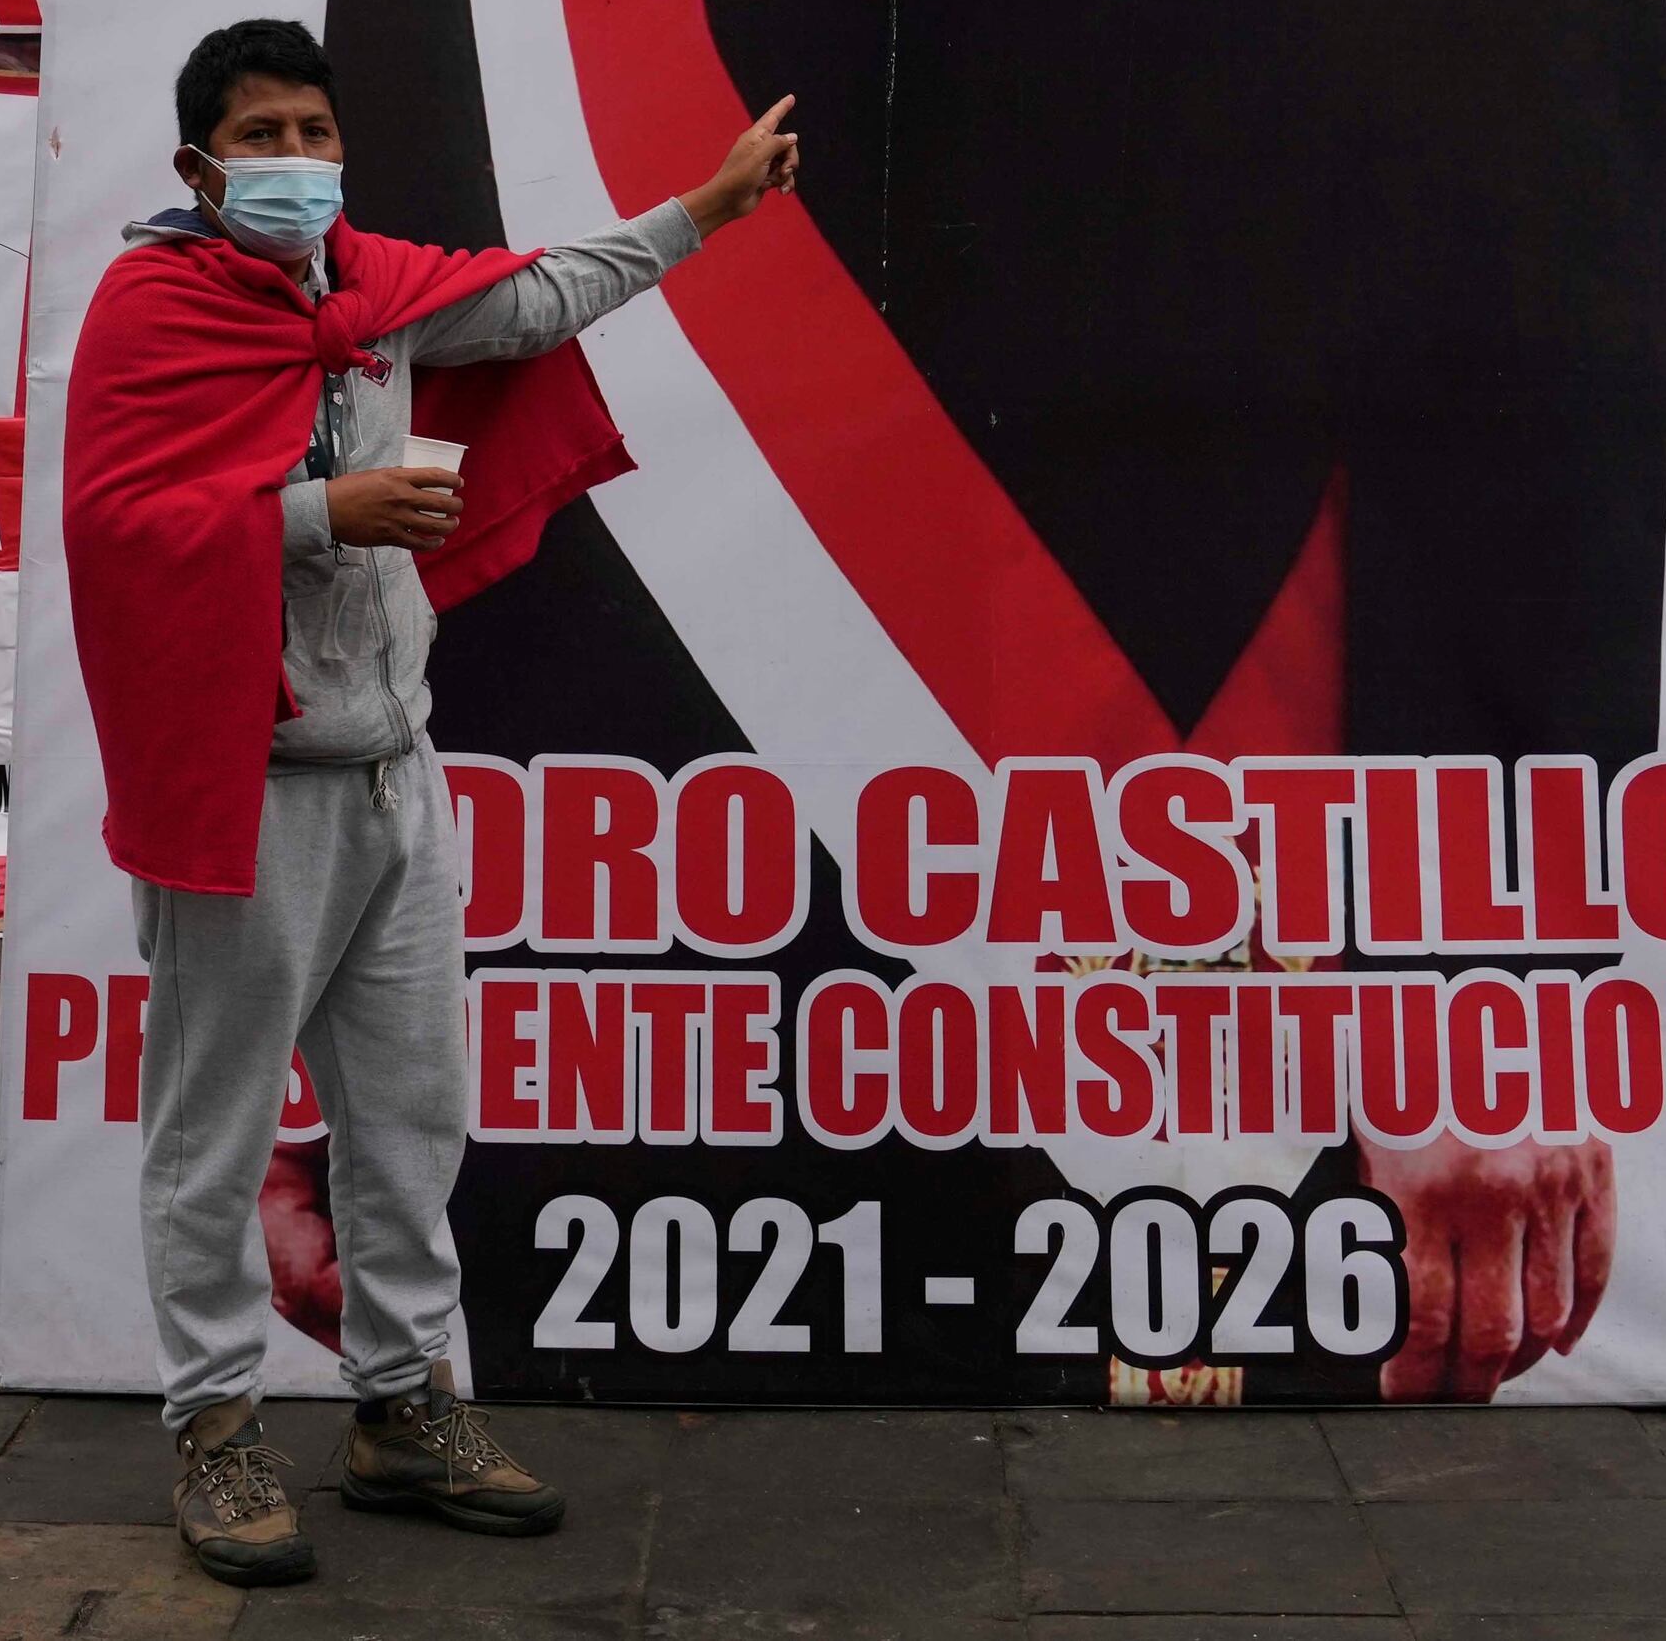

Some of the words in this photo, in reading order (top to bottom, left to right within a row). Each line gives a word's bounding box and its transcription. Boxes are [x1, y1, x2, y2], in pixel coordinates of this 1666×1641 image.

[441, 763, 804, 948] DRO
[531, 1196, 886, 1354] 2021
[1011, 1196, 1399, 1356] 2026
